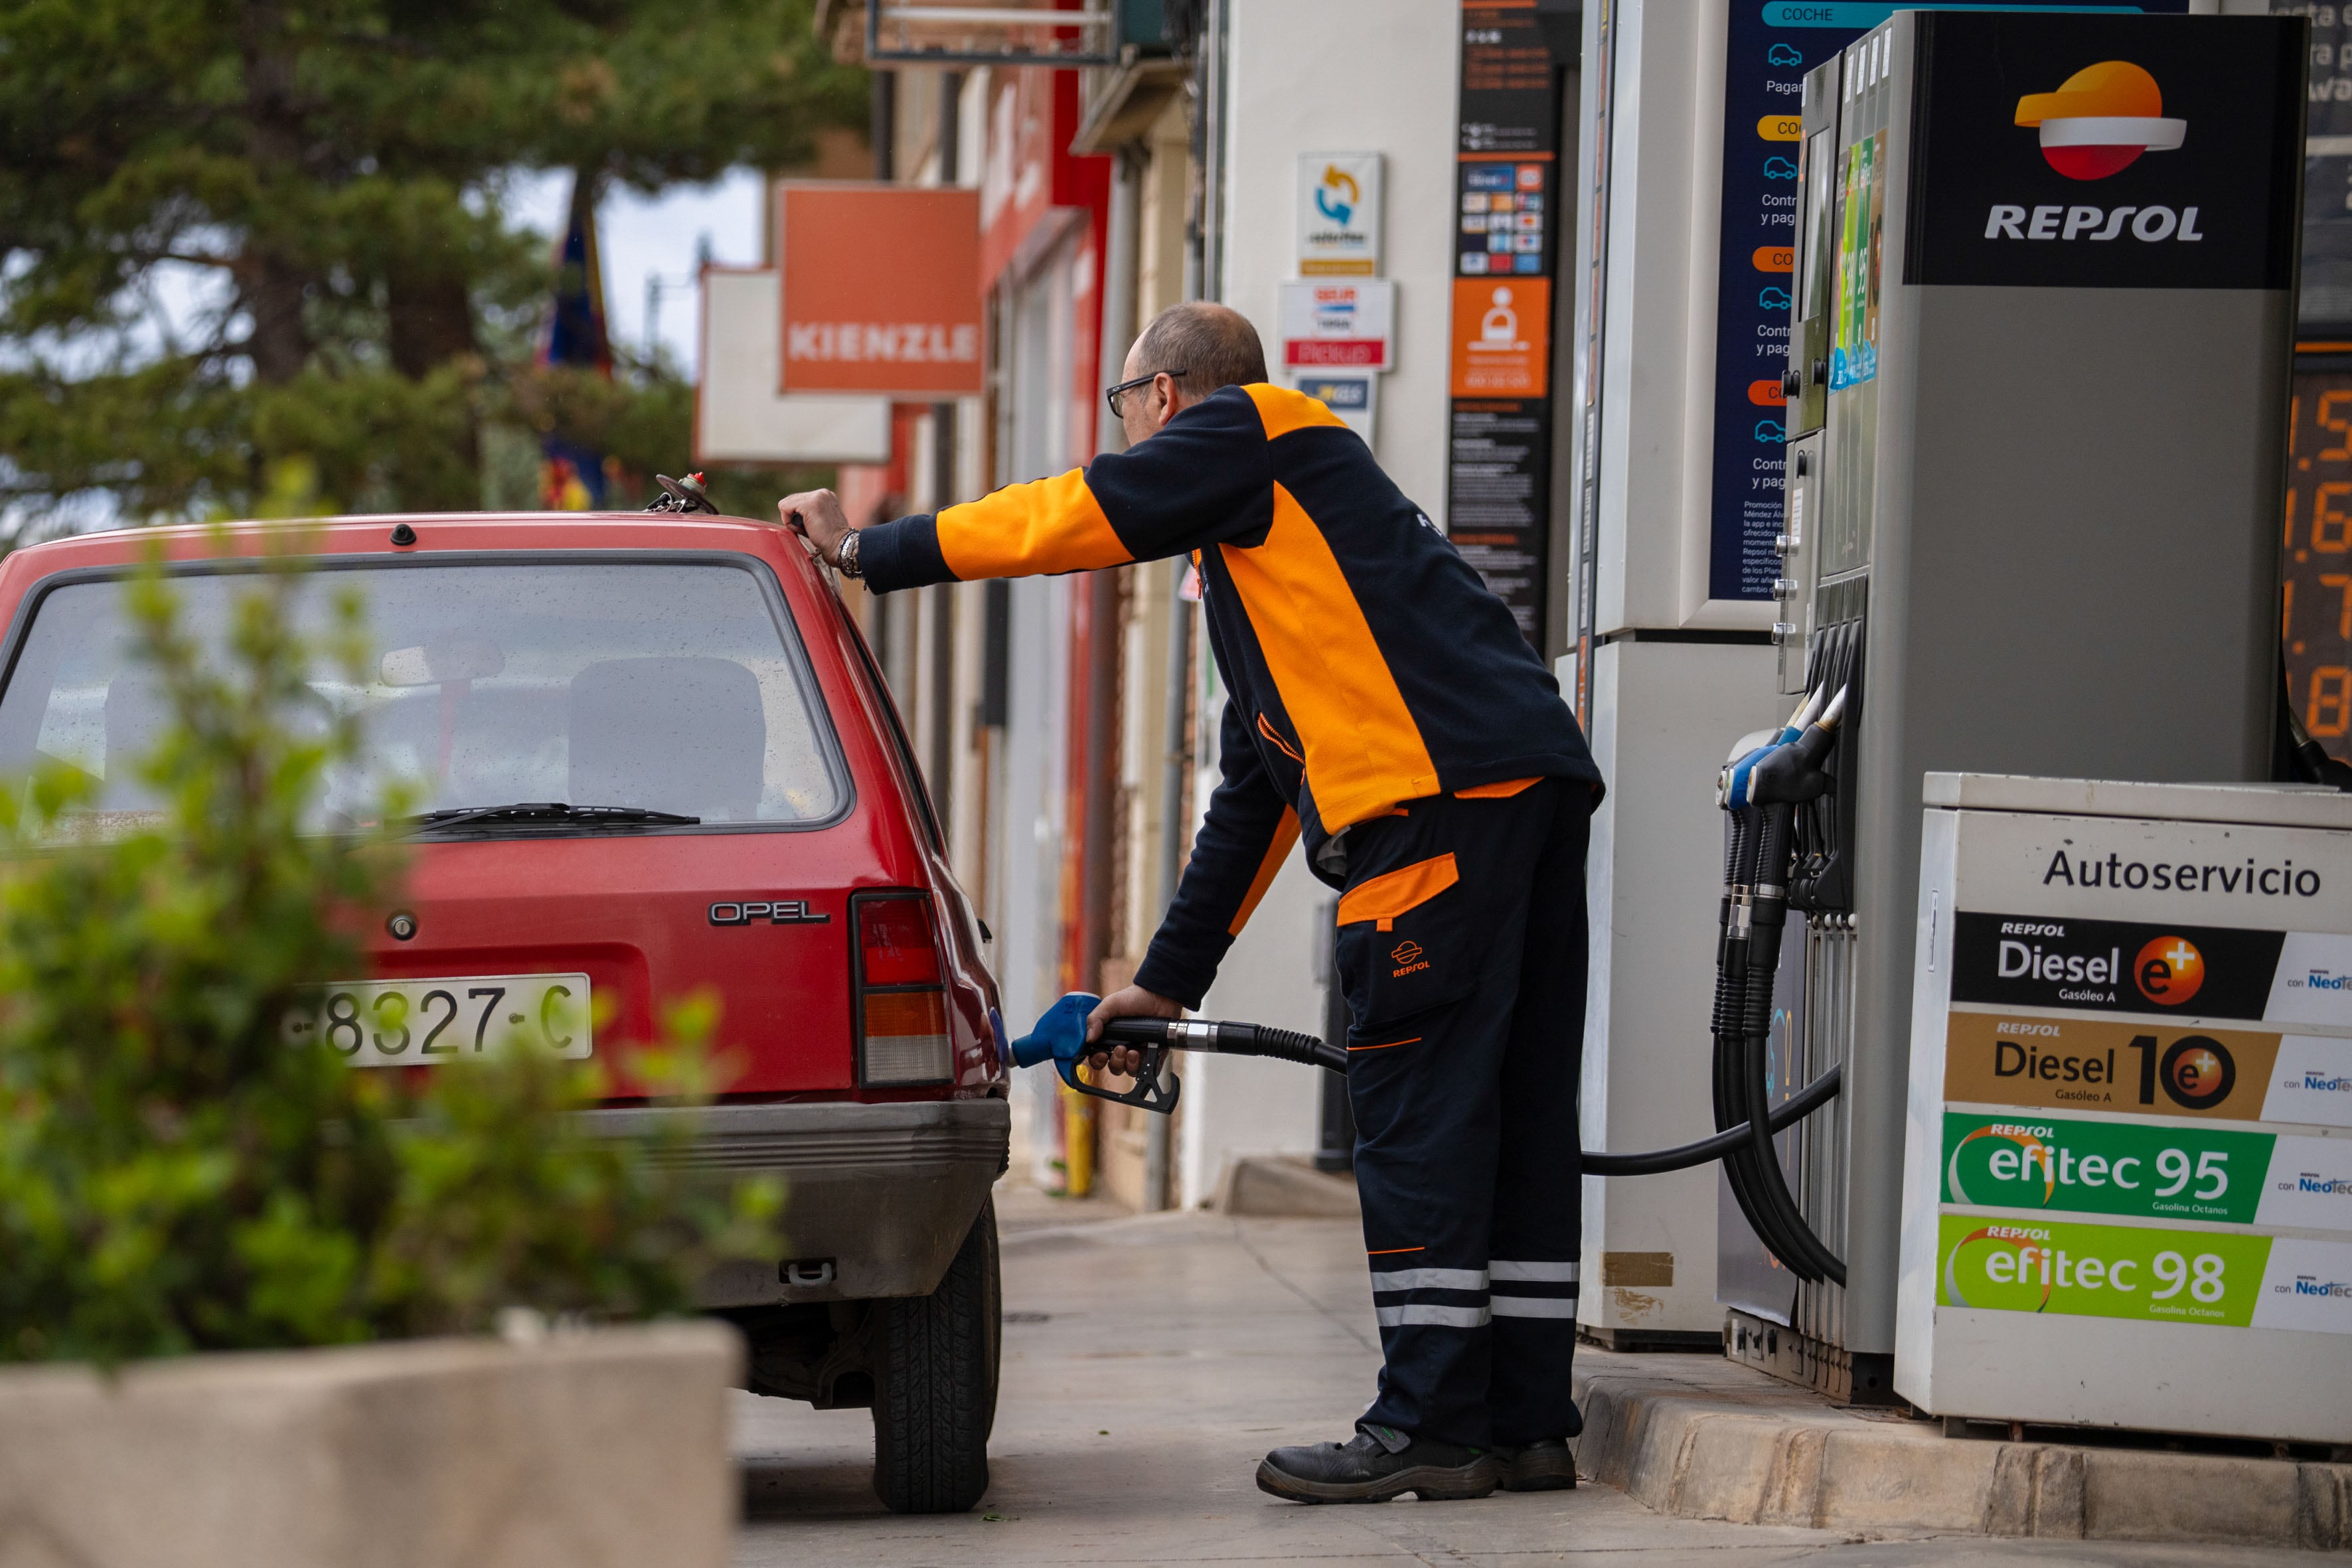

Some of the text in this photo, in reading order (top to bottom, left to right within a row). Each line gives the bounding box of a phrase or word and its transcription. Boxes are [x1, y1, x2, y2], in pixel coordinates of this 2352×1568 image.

[1782, 8, 1834, 21] COCHE
[1778, 122, 1802, 134] CO
[1761, 214, 1768, 225] y
[1984, 205, 2203, 242] REPSOL
[788, 322, 979, 362] KIENZLE
[1757, 344, 1764, 356] y
[1753, 477, 1759, 489] y
[1744, 501, 1782, 509] Promoción
[1743, 548, 1767, 556] Repsol
[2043, 850, 2321, 897] Autoservicio
[710, 901, 828, 923] OPEL
[2001, 921, 2065, 937] REPSOL
[1393, 961, 1431, 978] REPSOL
[1998, 940, 2120, 984] Diesel
[2288, 979, 2304, 988] con
[2059, 988, 2116, 1002] Gasóleo A
[1996, 1022, 2061, 1037] REPSOL
[1994, 1040, 2114, 1084] Diesel
[2055, 1089, 2112, 1103] Gasóleo A
[1990, 1123, 2054, 1138] REPSOL
[1988, 1144, 2229, 1200] efitec 95
[2152, 1202, 2228, 1215] Gasolina Octanos
[1987, 1225, 2051, 1241] REPSOL
[1986, 1247, 2225, 1303] efitec 98
[2150, 1304, 2225, 1318] Gasolina Octanos
